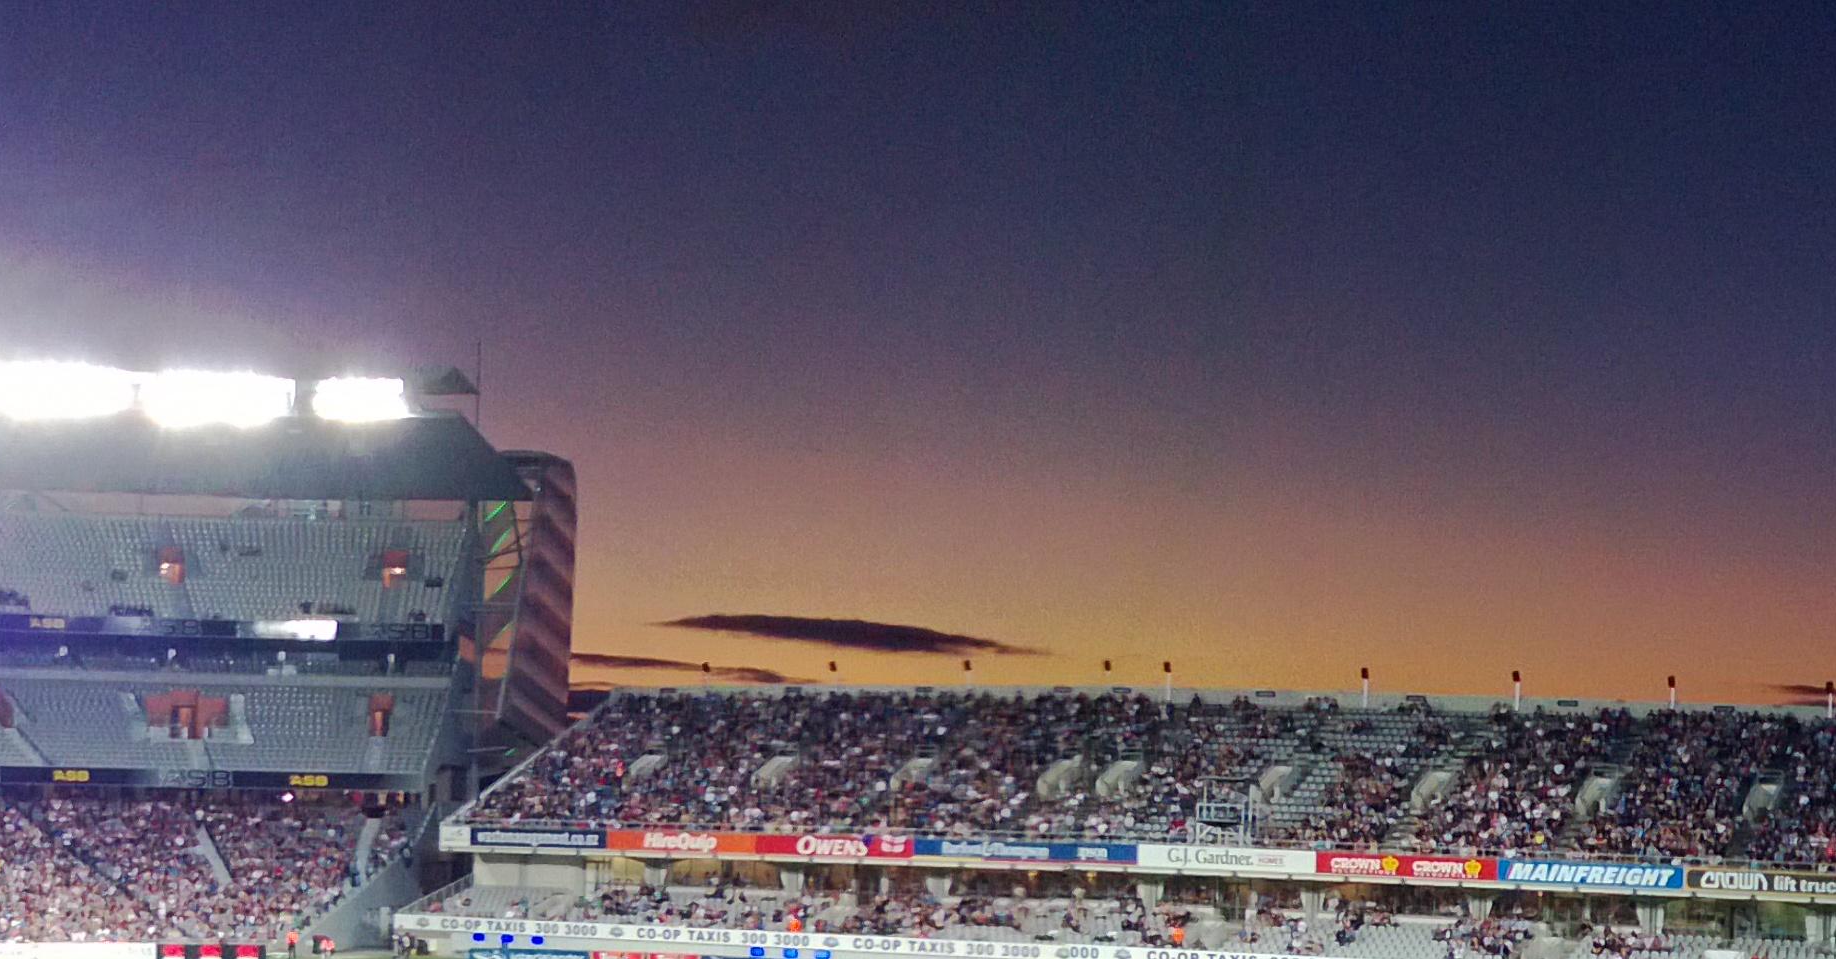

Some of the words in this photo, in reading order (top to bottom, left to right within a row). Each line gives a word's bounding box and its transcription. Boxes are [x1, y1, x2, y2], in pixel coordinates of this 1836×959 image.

[53, 769, 90, 783] ASB
[289, 774, 328, 788] ASB
[1167, 847, 1191, 865] G.J.
[1331, 858, 1382, 873] CROWN
[1412, 861, 1465, 875] CROWN
[1508, 862, 1676, 887] MAINFREIGHT
[1700, 871, 1768, 890] CROWN
[1773, 875, 1797, 891] lift
[441, 918, 483, 932] CO-OP
[487, 919, 526, 934] TAXIS
[536, 921, 561, 935] 300
[565, 922, 597, 936] 3000
[636, 927, 684, 941] CO-OP
[688, 929, 731, 943] TAXIS
[741, 931, 767, 945] 300
[774, 933, 810, 947] 3000
[852, 937, 901, 952] CO-OP
[907, 940, 955, 955] TAXIS
[967, 943, 995, 957] 300
[1001, 944, 1040, 959] 3000
